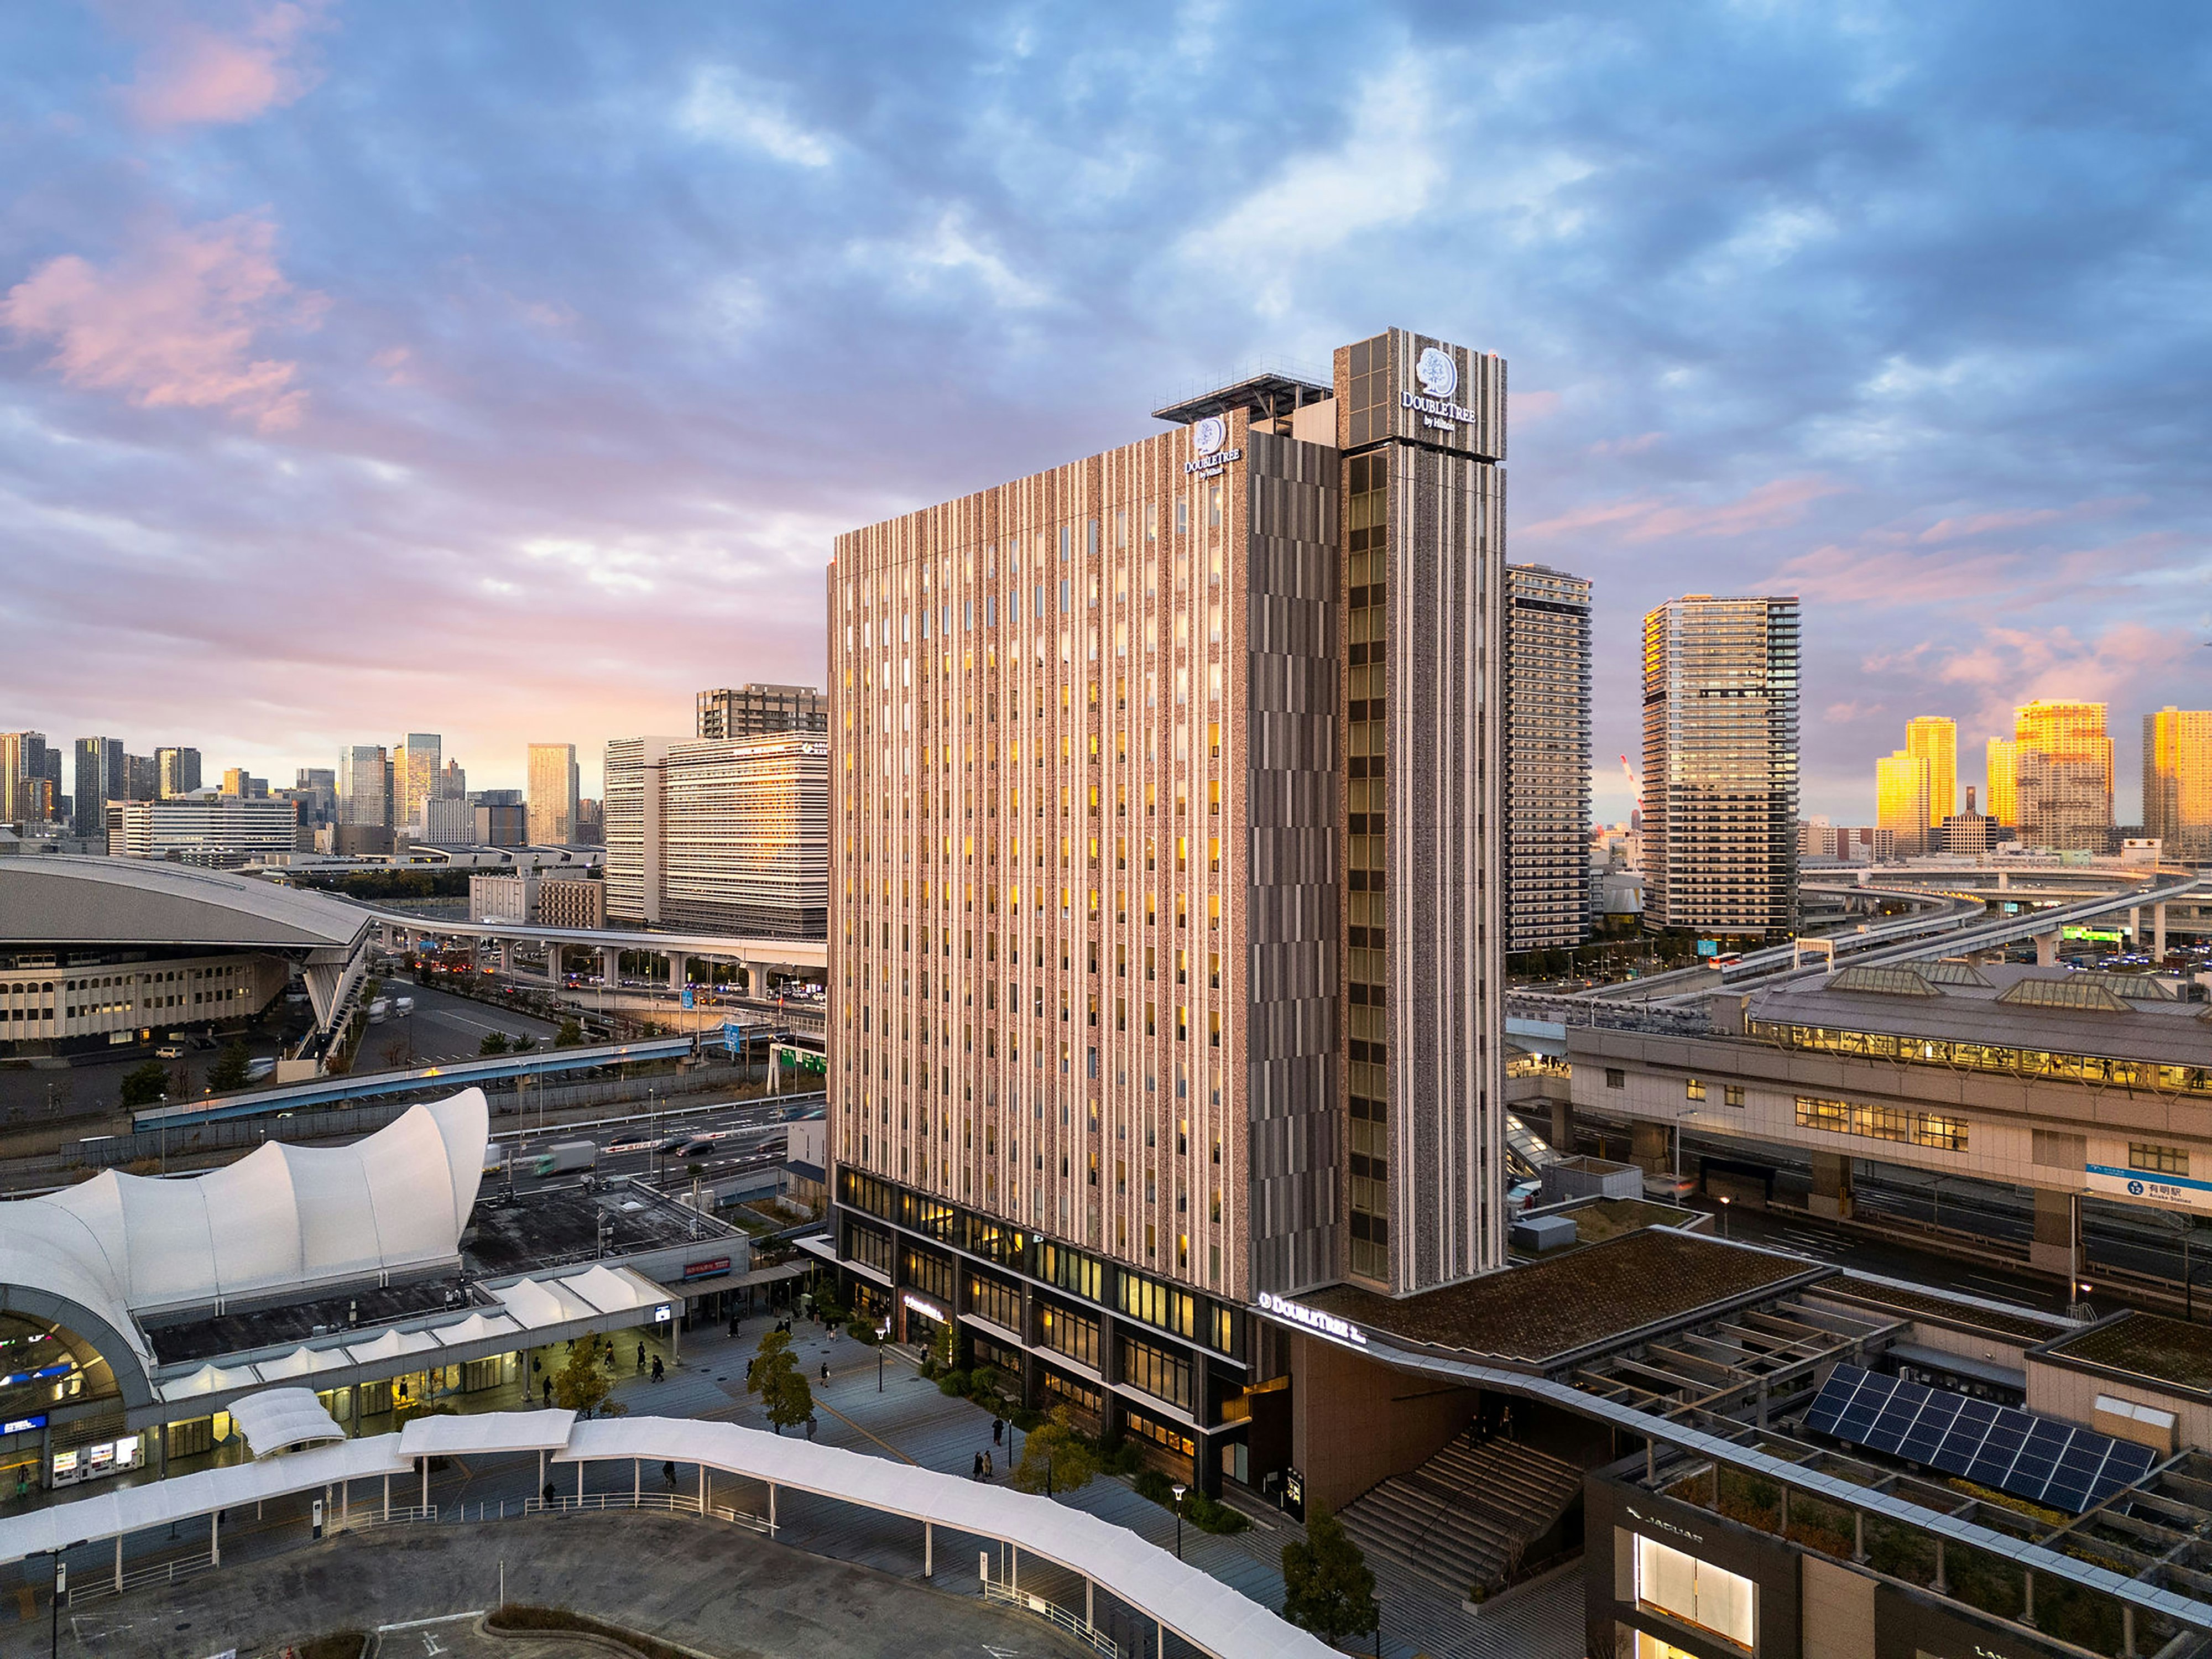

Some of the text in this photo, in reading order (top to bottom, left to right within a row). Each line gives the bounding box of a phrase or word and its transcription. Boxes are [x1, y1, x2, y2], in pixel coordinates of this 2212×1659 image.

[1402, 391, 1476, 423] DOUBLETREE
[1424, 415, 1455, 431] by Hilton
[1185, 448, 1239, 474] DOUBLETREE
[2149, 1183, 2182, 1197] 有明駅
[1645, 1517, 1703, 1544] JAGUAR
[1975, 1646, 2007, 1659] LA
